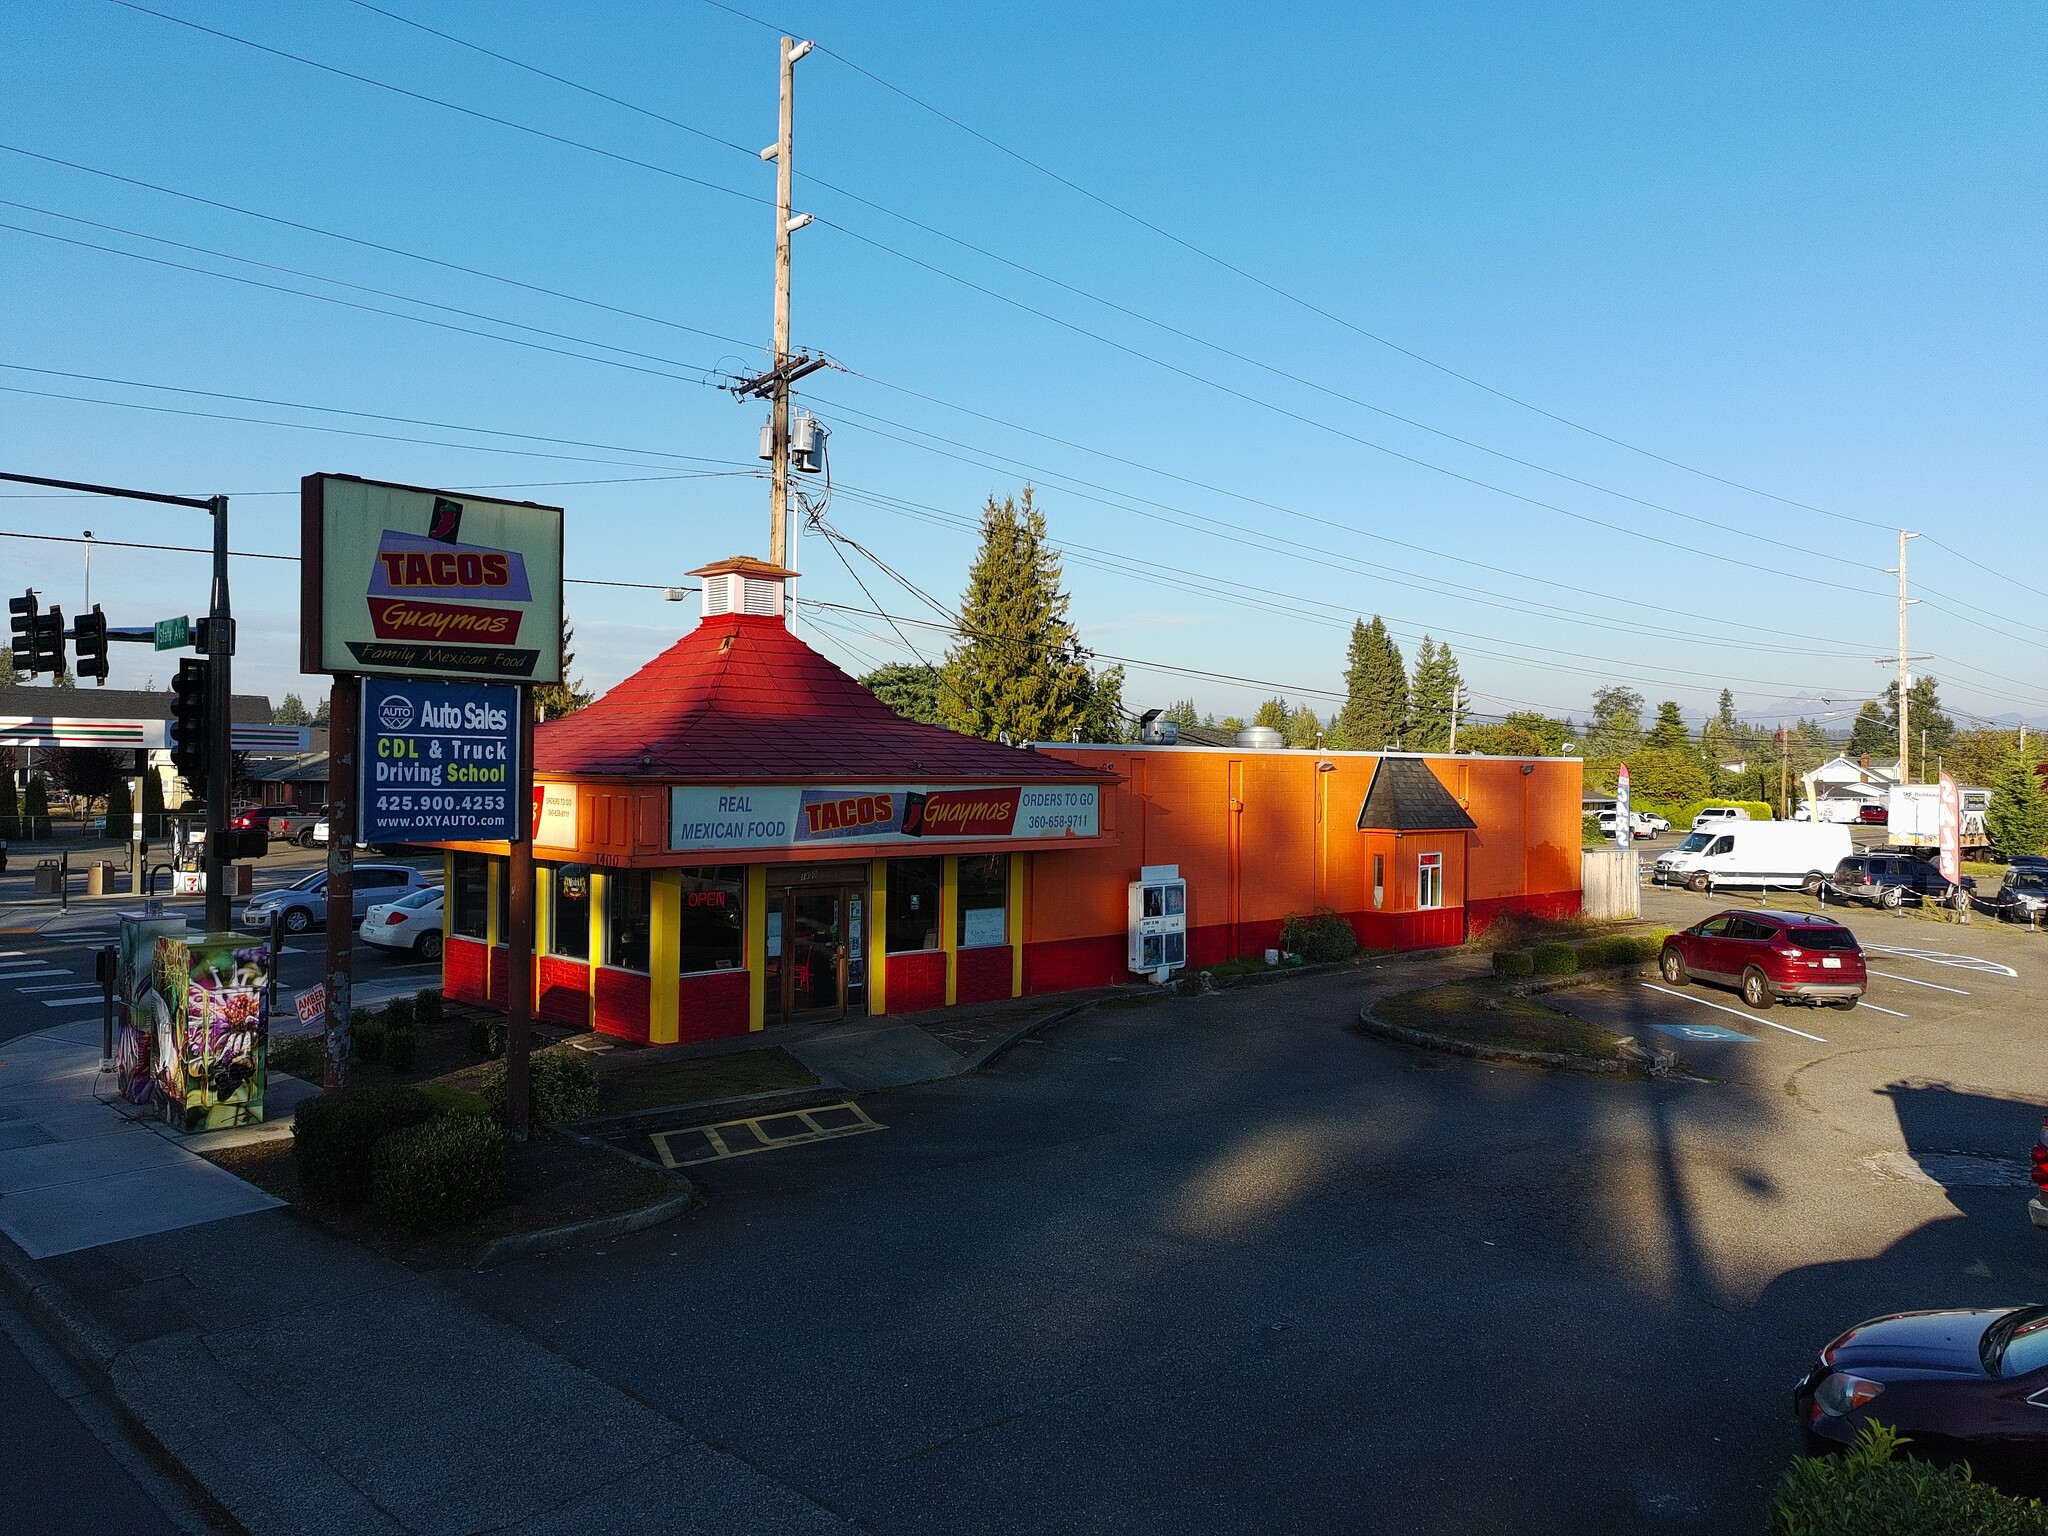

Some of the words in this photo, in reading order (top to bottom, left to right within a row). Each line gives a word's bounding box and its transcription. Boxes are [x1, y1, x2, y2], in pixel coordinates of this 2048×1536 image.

[380, 551, 510, 588] TACOS
[382, 603, 510, 637] Guaymas
[174, 626, 185, 640] Ave
[361, 644, 416, 666] Family
[422, 649, 487, 665] Mexican
[494, 653, 527, 667] Food
[382, 707, 411, 717] AUTO
[420, 700, 461, 729] Auto
[464, 702, 507, 730] Sales
[377, 738, 419, 758] CDL
[428, 739, 442, 759] &
[452, 740, 507, 760] Truck
[376, 762, 442, 786] Driving
[447, 763, 505, 782] School
[377, 796, 505, 811] 425.900.4253
[718, 796, 752, 813] REAL
[1022, 794, 1062, 807] ORDERS
[1065, 793, 1078, 806] TO
[1079, 792, 1094, 806] GO
[377, 815, 505, 827] www.OXYAUTO.com
[804, 794, 894, 834] TACOS
[923, 795, 1011, 832] Guaymas
[1028, 814, 1088, 829] 360-658-9711
[681, 822, 744, 840] MEXICAN
[747, 821, 785, 838] FOOD
[596, 853, 619, 867] 1400
[187, 877, 197, 891] 7
[687, 891, 725, 907] OPEN
[298, 990, 325, 1011] AMBER
